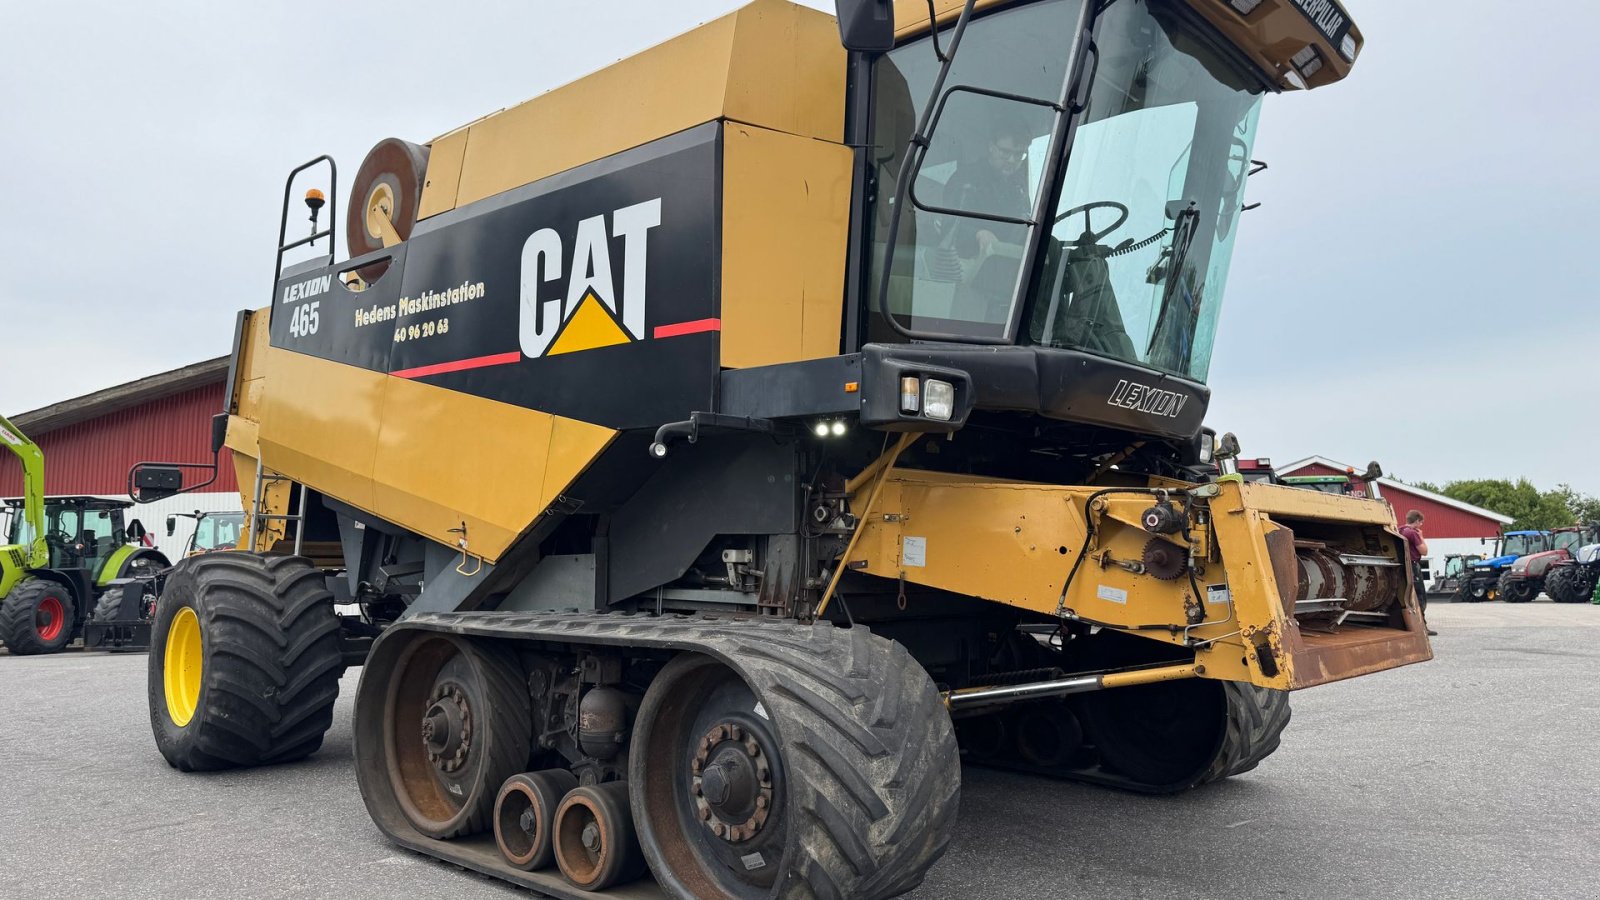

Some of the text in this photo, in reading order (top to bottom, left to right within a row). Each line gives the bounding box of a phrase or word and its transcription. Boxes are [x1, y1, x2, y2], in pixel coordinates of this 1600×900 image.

[1294, 0, 1343, 39] ERPILLAR
[282, 274, 332, 303] LEXION
[519, 197, 662, 359] CAT
[289, 301, 320, 338] 465
[355, 280, 485, 327] Hedens Maskinstation
[394, 318, 449, 343] 40 96 20 63
[1107, 379, 1188, 418] LEXION
